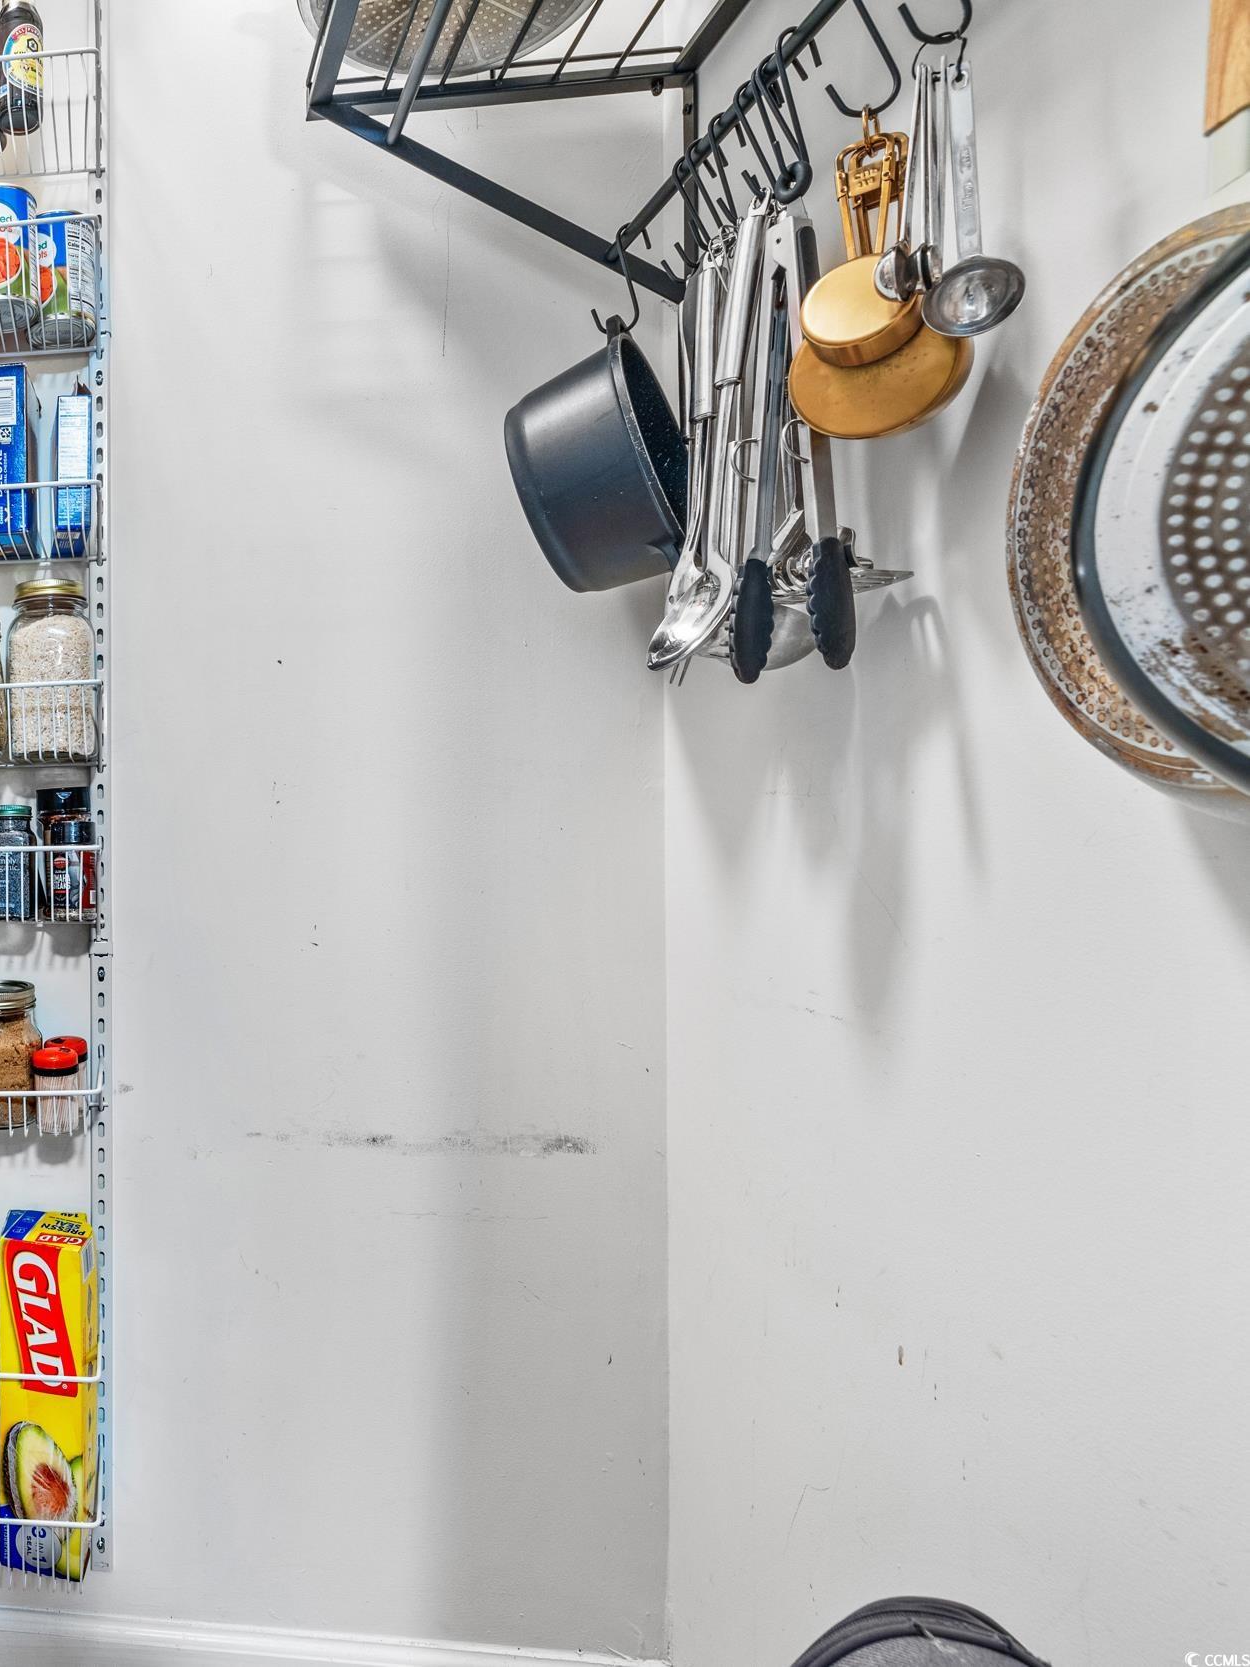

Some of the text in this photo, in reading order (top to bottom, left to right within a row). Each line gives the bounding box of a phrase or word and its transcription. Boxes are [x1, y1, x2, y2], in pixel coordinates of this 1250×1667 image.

[39, 1234, 83, 1245] GLAD
[12, 1250, 65, 1387] GLAD
[31, 1526, 47, 1539] 3
